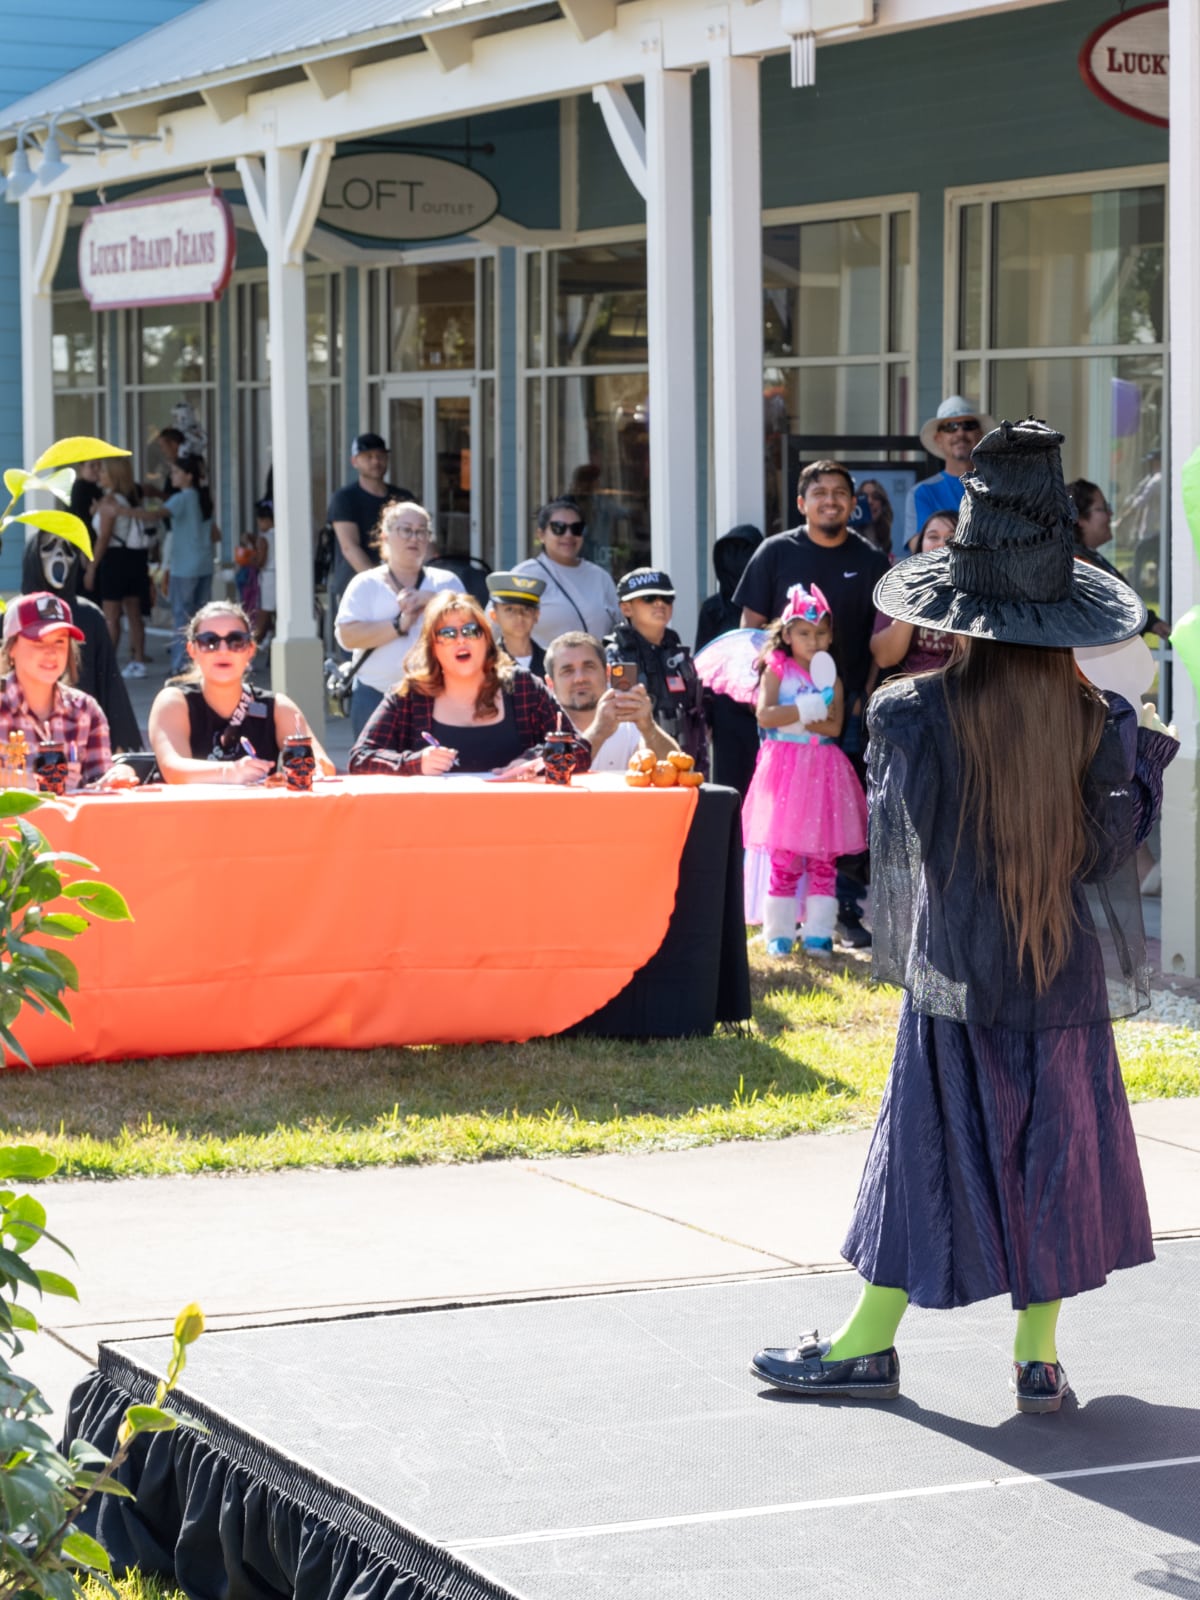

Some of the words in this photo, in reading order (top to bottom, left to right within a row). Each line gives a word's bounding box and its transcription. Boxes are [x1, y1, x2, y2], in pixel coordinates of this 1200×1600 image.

[1107, 47, 1169, 76] LUCK
[322, 178, 424, 211] LOFT
[421, 202, 476, 216] OUTLET
[90, 241, 127, 276] LUCKY
[130, 235, 172, 271] BRAND
[174, 229, 215, 267] JEANS
[628, 573, 660, 590] SWAT
